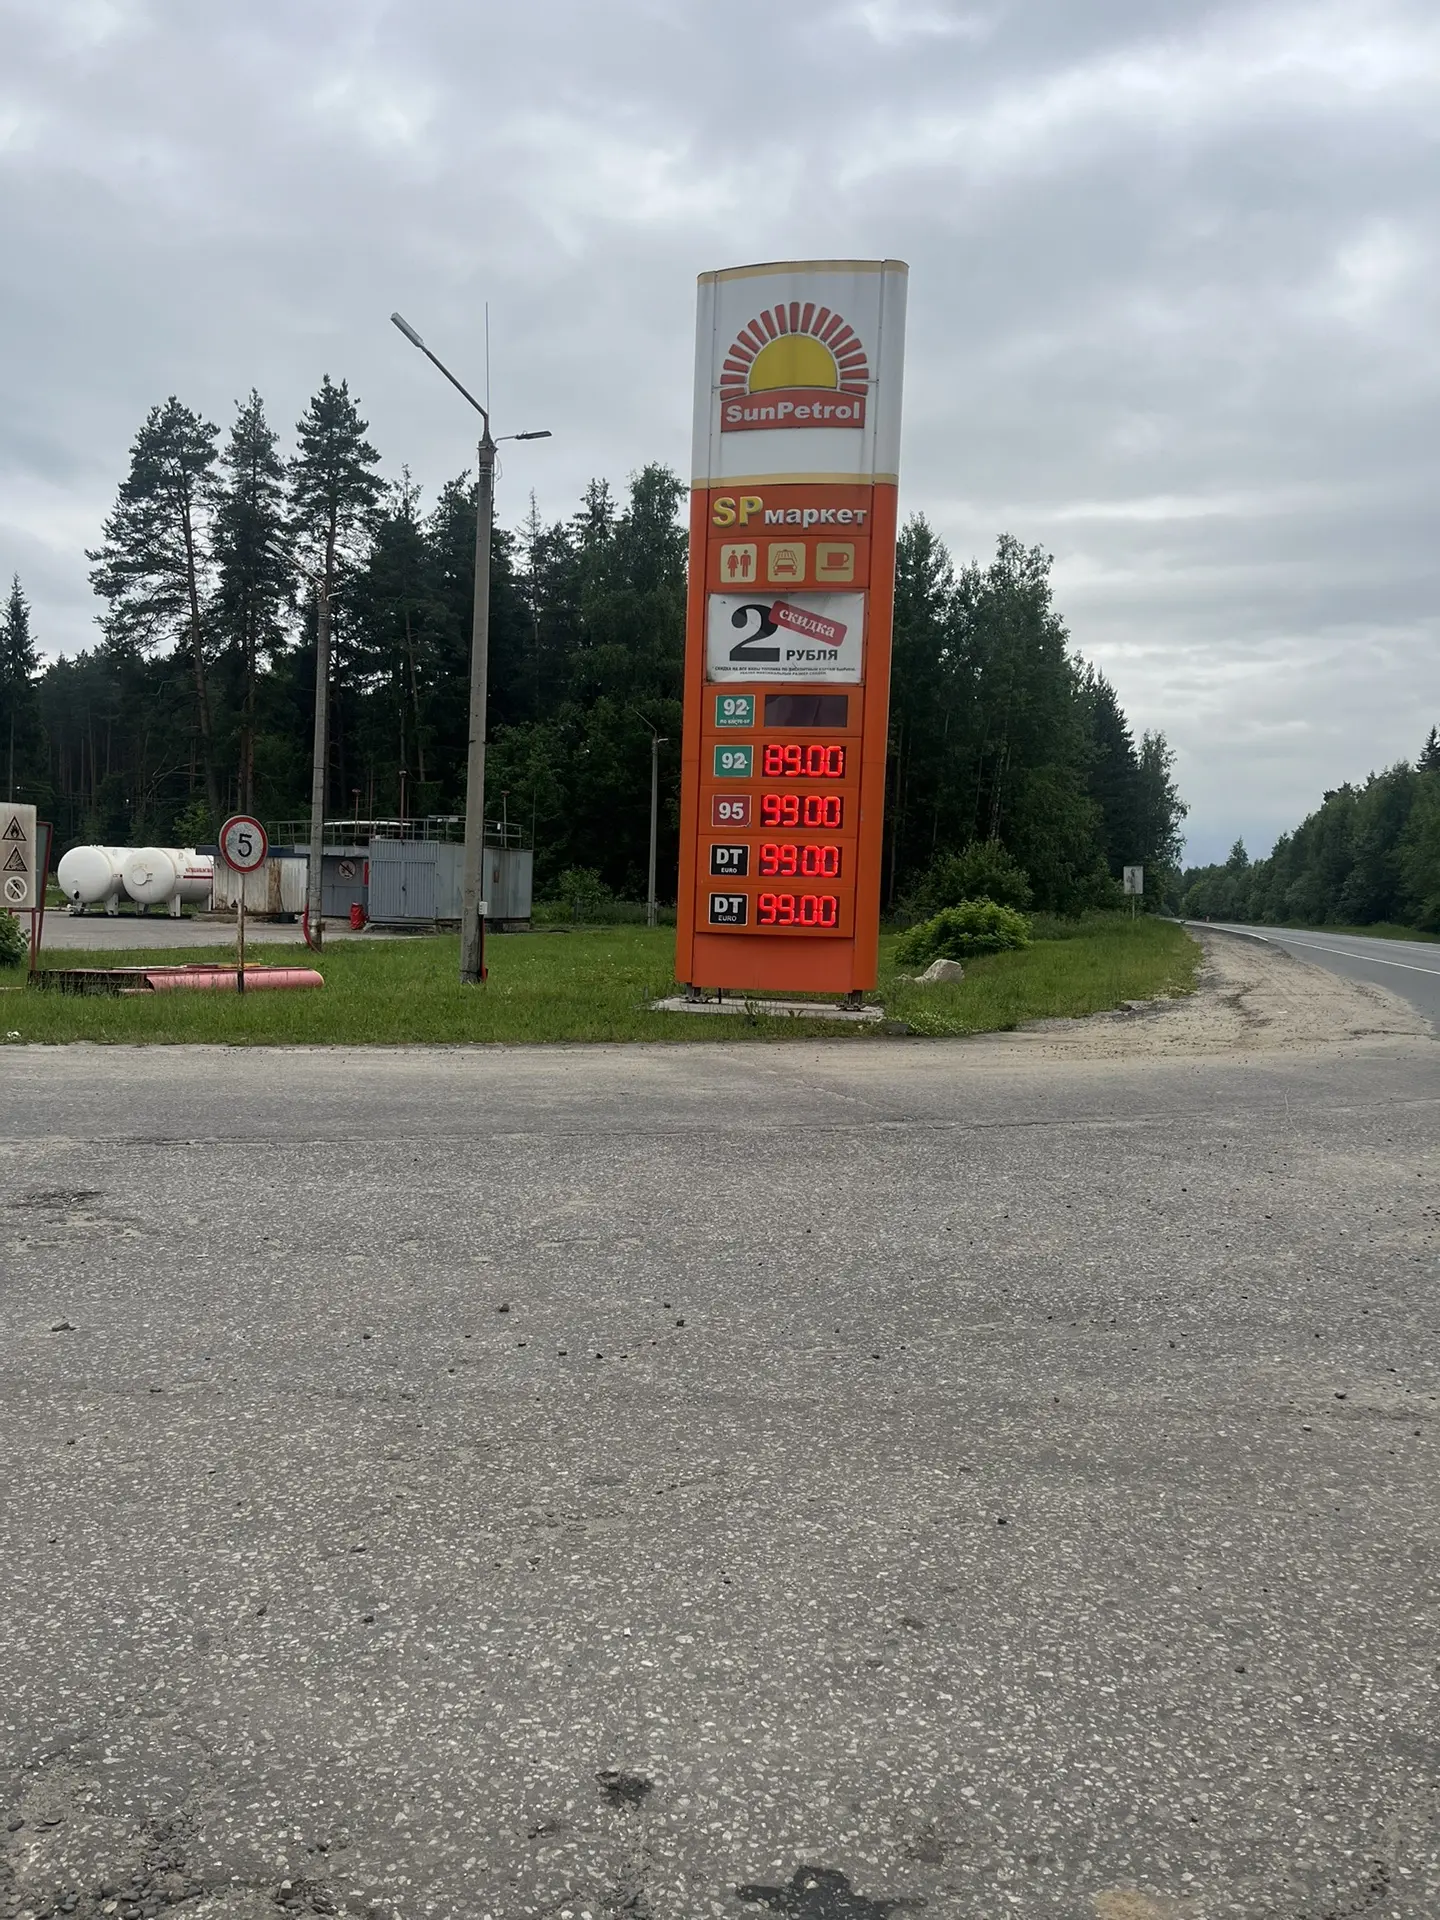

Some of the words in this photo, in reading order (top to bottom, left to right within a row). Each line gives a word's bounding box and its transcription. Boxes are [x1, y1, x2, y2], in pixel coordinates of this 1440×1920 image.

[725, 401, 860, 423] SunPetrol
[712, 495, 764, 528] SP
[764, 507, 868, 529] маркет
[729, 604, 780, 662] 2
[778, 608, 835, 638] скидка
[786, 649, 838, 661] РУБЛЯ
[723, 698, 747, 716] 92
[721, 752, 746, 769] 92
[765, 744, 843, 777] 89.00
[718, 802, 744, 820] 95
[237, 833, 252, 858] 5
[716, 848, 743, 865] DT
[713, 897, 743, 914] DT
[759, 893, 836, 927] 99.00
[718, 914, 737, 922] EURO
